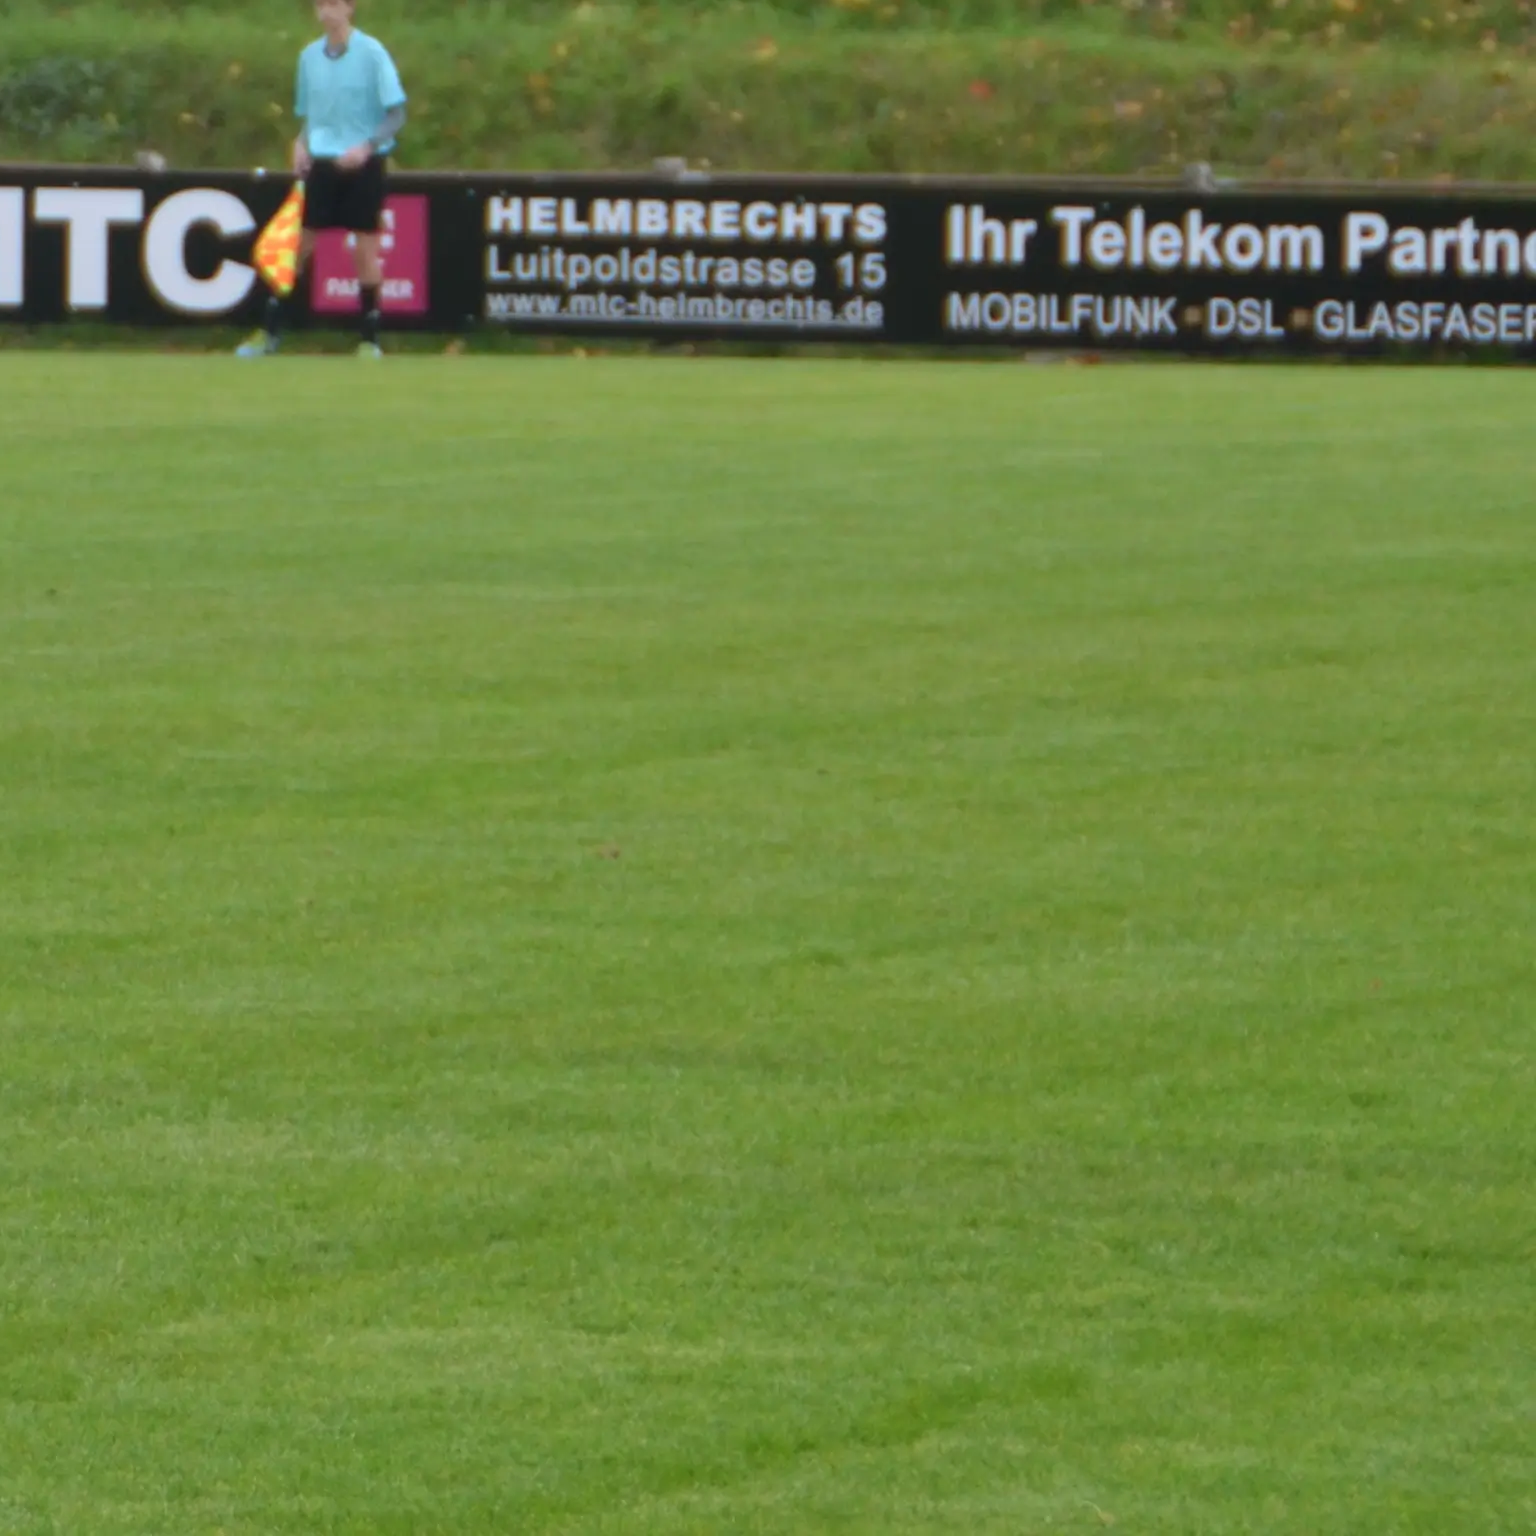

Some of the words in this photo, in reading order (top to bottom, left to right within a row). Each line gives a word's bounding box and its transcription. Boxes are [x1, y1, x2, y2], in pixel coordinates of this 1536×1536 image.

[486, 196, 887, 241] HELMBRECHTS
[947, 204, 1038, 263] Ihr
[1050, 206, 1325, 272] Telekom
[486, 245, 816, 289] Luitpoldstrasse
[836, 252, 887, 290] 15
[485, 292, 884, 327] www.mtc-helmbrechts.de
[945, 291, 1178, 335] MOBILFUNK
[1208, 297, 1285, 336] DSL
